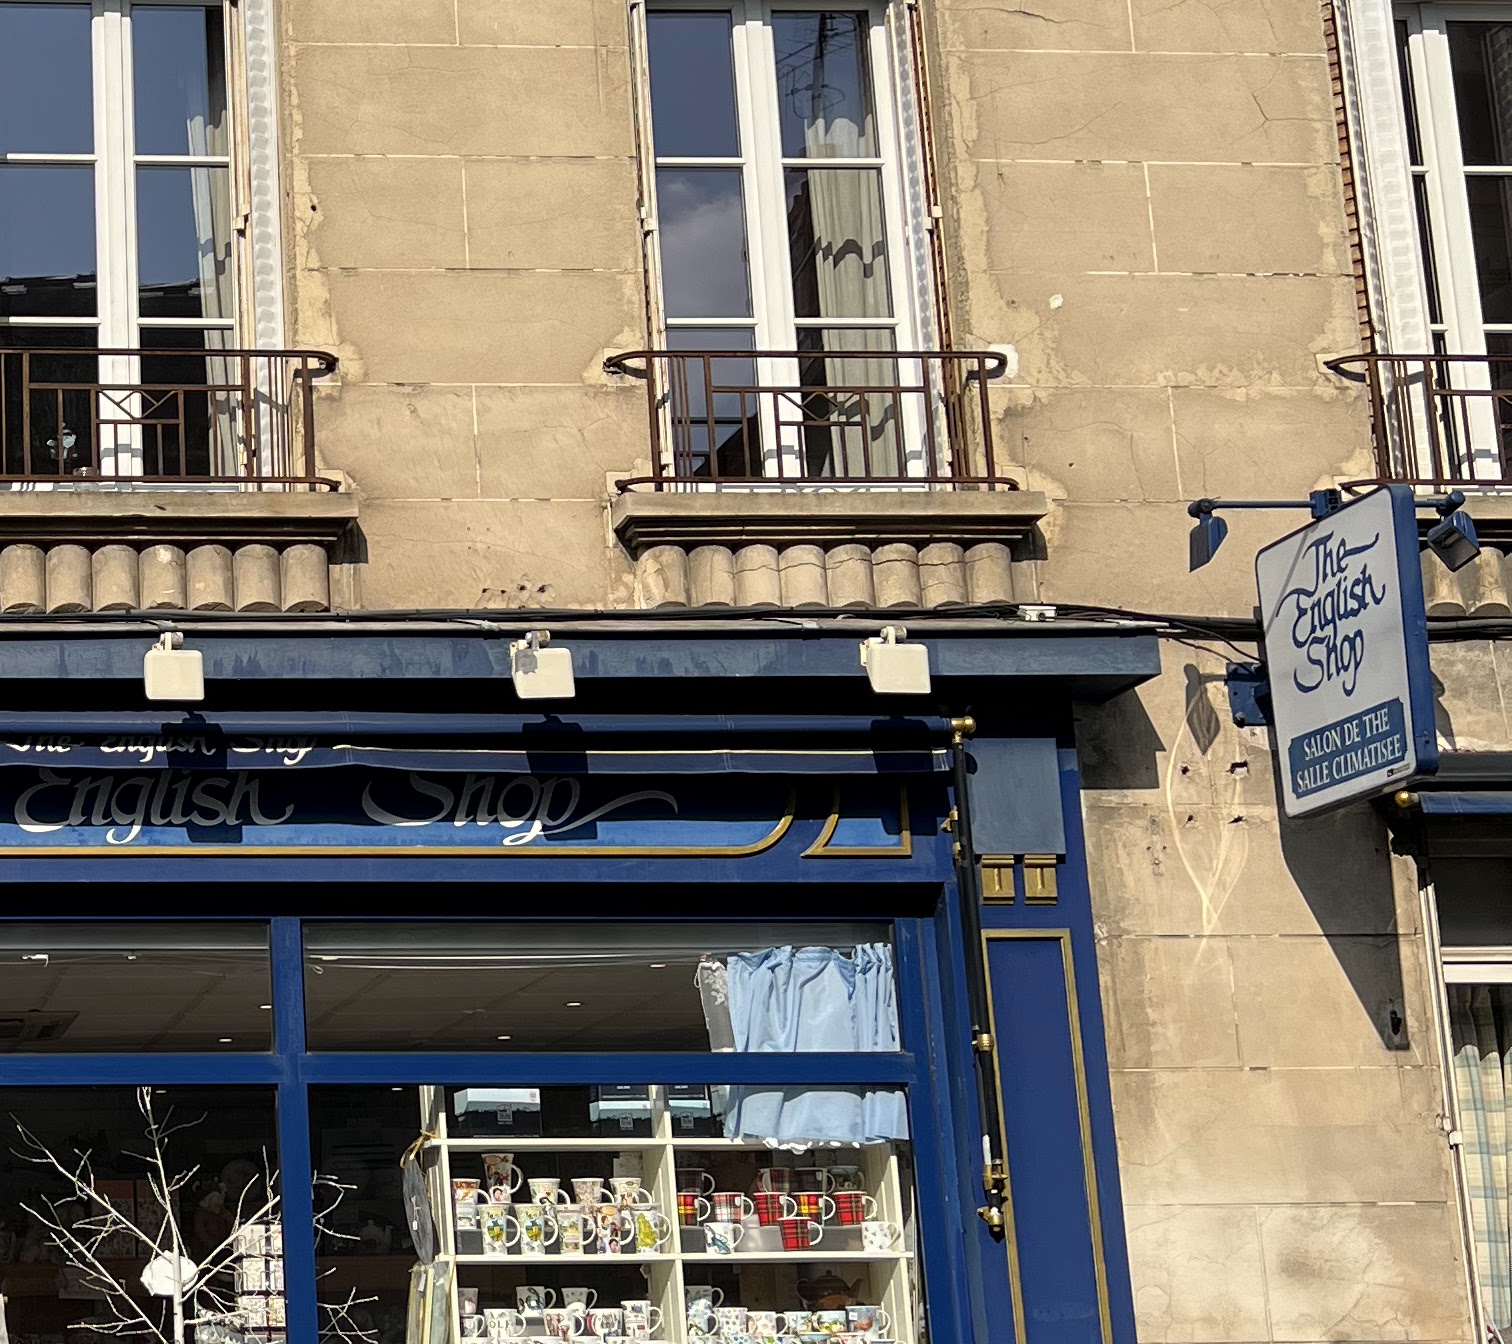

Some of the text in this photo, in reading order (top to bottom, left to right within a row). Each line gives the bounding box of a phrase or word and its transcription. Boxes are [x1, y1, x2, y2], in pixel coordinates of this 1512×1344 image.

[1301, 530, 1379, 598] The
[1277, 563, 1386, 648] English
[1293, 629, 1364, 697] Shop
[1296, 734, 1402, 793] SALLE CLIMATISEE
[1303, 708, 1390, 761] SALON DE THE
[14, 768, 294, 845] English
[361, 772, 678, 846] Shop
